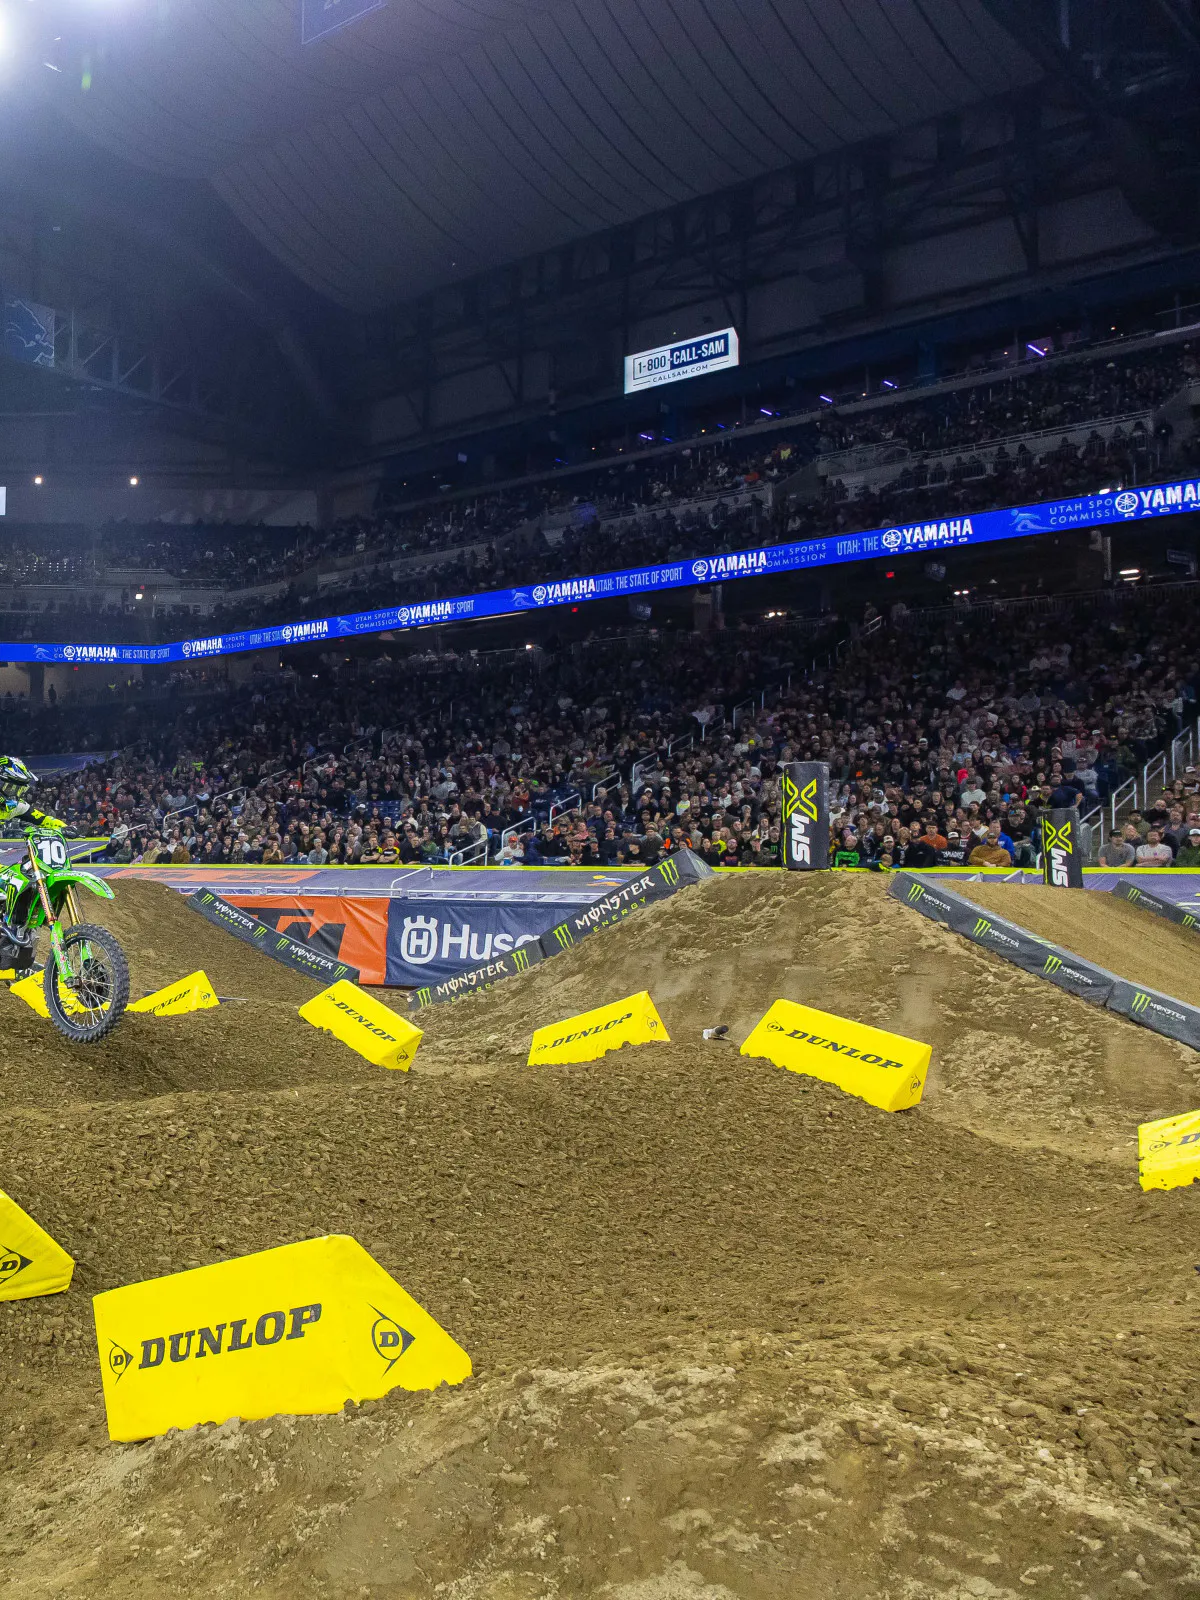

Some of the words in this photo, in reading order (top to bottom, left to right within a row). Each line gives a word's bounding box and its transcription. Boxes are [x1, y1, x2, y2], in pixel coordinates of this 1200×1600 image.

[637, 339, 725, 374] 1-800-CALL-SAM
[652, 364, 709, 383] CALLSAM.COM
[1139, 482, 1200, 509] YAMA
[1049, 503, 1082, 515] UTAH
[1089, 498, 1112, 509] SPO
[1050, 509, 1116, 525] COMMISSI
[903, 519, 973, 544] YAMAHA
[766, 549, 784, 559] TAH
[789, 543, 826, 555] SPORTS
[837, 538, 861, 556] UTAH:
[863, 536, 879, 551] THE
[709, 551, 767, 574] YAMAHA
[765, 553, 827, 568] OMMISSION
[547, 578, 595, 598] YAMAHA
[616, 576, 628, 590] THE
[629, 572, 650, 588] STATE
[651, 570, 660, 584] OF
[661, 567, 683, 583] SPORT
[374, 611, 398, 619] SPORTS
[409, 602, 451, 619] YAMAHA
[456, 600, 475, 614] SPORT
[293, 621, 328, 637] YAMAHA
[355, 619, 398, 630] COMMISSION
[76, 646, 117, 658] YAMAHA
[191, 638, 223, 652] YAMAHA
[38, 840, 66, 865] 10
[575, 875, 656, 931] MONSTER
[922, 892, 951, 912] MONSTER
[213, 901, 255, 930] MONSTER
[593, 896, 647, 932] ENERGY
[441, 924, 541, 960] Hus
[989, 928, 1020, 948] MONSTER
[290, 944, 334, 970] MONSTER
[437, 960, 508, 997] MONSTER
[1061, 965, 1093, 985] MONSTER
[334, 1001, 397, 1042] DUNLOP
[1150, 1002, 1187, 1023] MONSTER
[550, 1012, 632, 1048] DUNLOP
[784, 1029, 904, 1070] DUNLOP
[138, 1303, 323, 1370] DUNLOP
